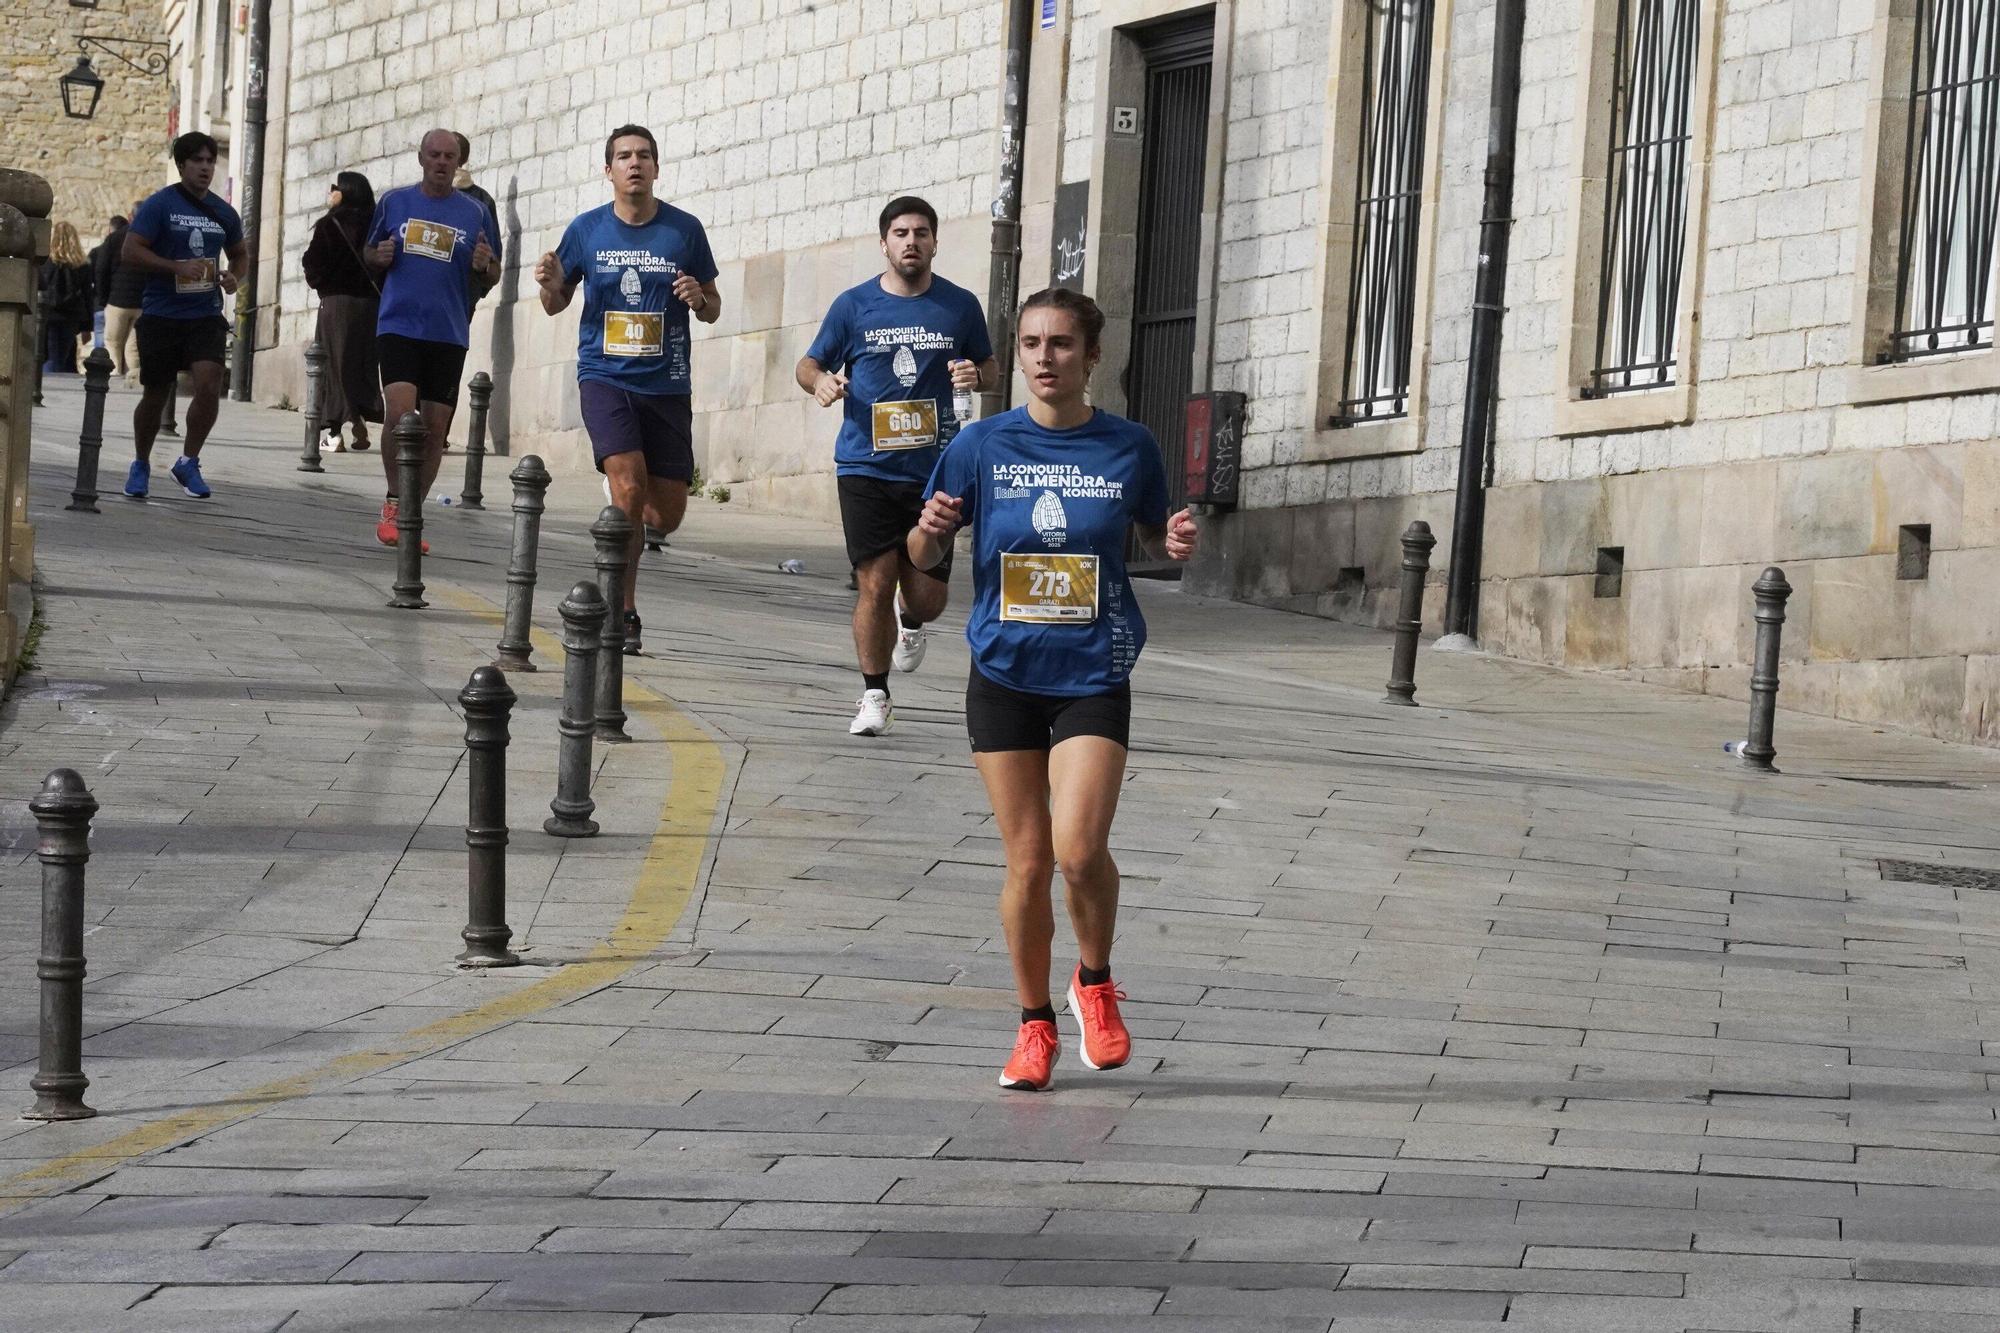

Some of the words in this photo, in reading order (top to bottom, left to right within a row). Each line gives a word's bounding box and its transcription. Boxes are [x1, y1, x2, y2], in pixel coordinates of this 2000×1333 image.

[422, 229, 439, 245] 82
[608, 256, 666, 266] ALMENDRA
[639, 265, 676, 273] KONKISTA
[625, 323, 644, 340] 40
[875, 326, 926, 337] CONQUISTA
[878, 332, 944, 345] ALMENDRA
[913, 342, 954, 350] KONKISTA
[889, 412, 921, 432] 660
[993, 464, 1008, 474] LA
[1009, 464, 1081, 475] CONQUISTA
[1012, 475, 1107, 488] ALMENDRA
[1062, 488, 1123, 500] KONKISTA
[1029, 571, 1070, 597] 273
